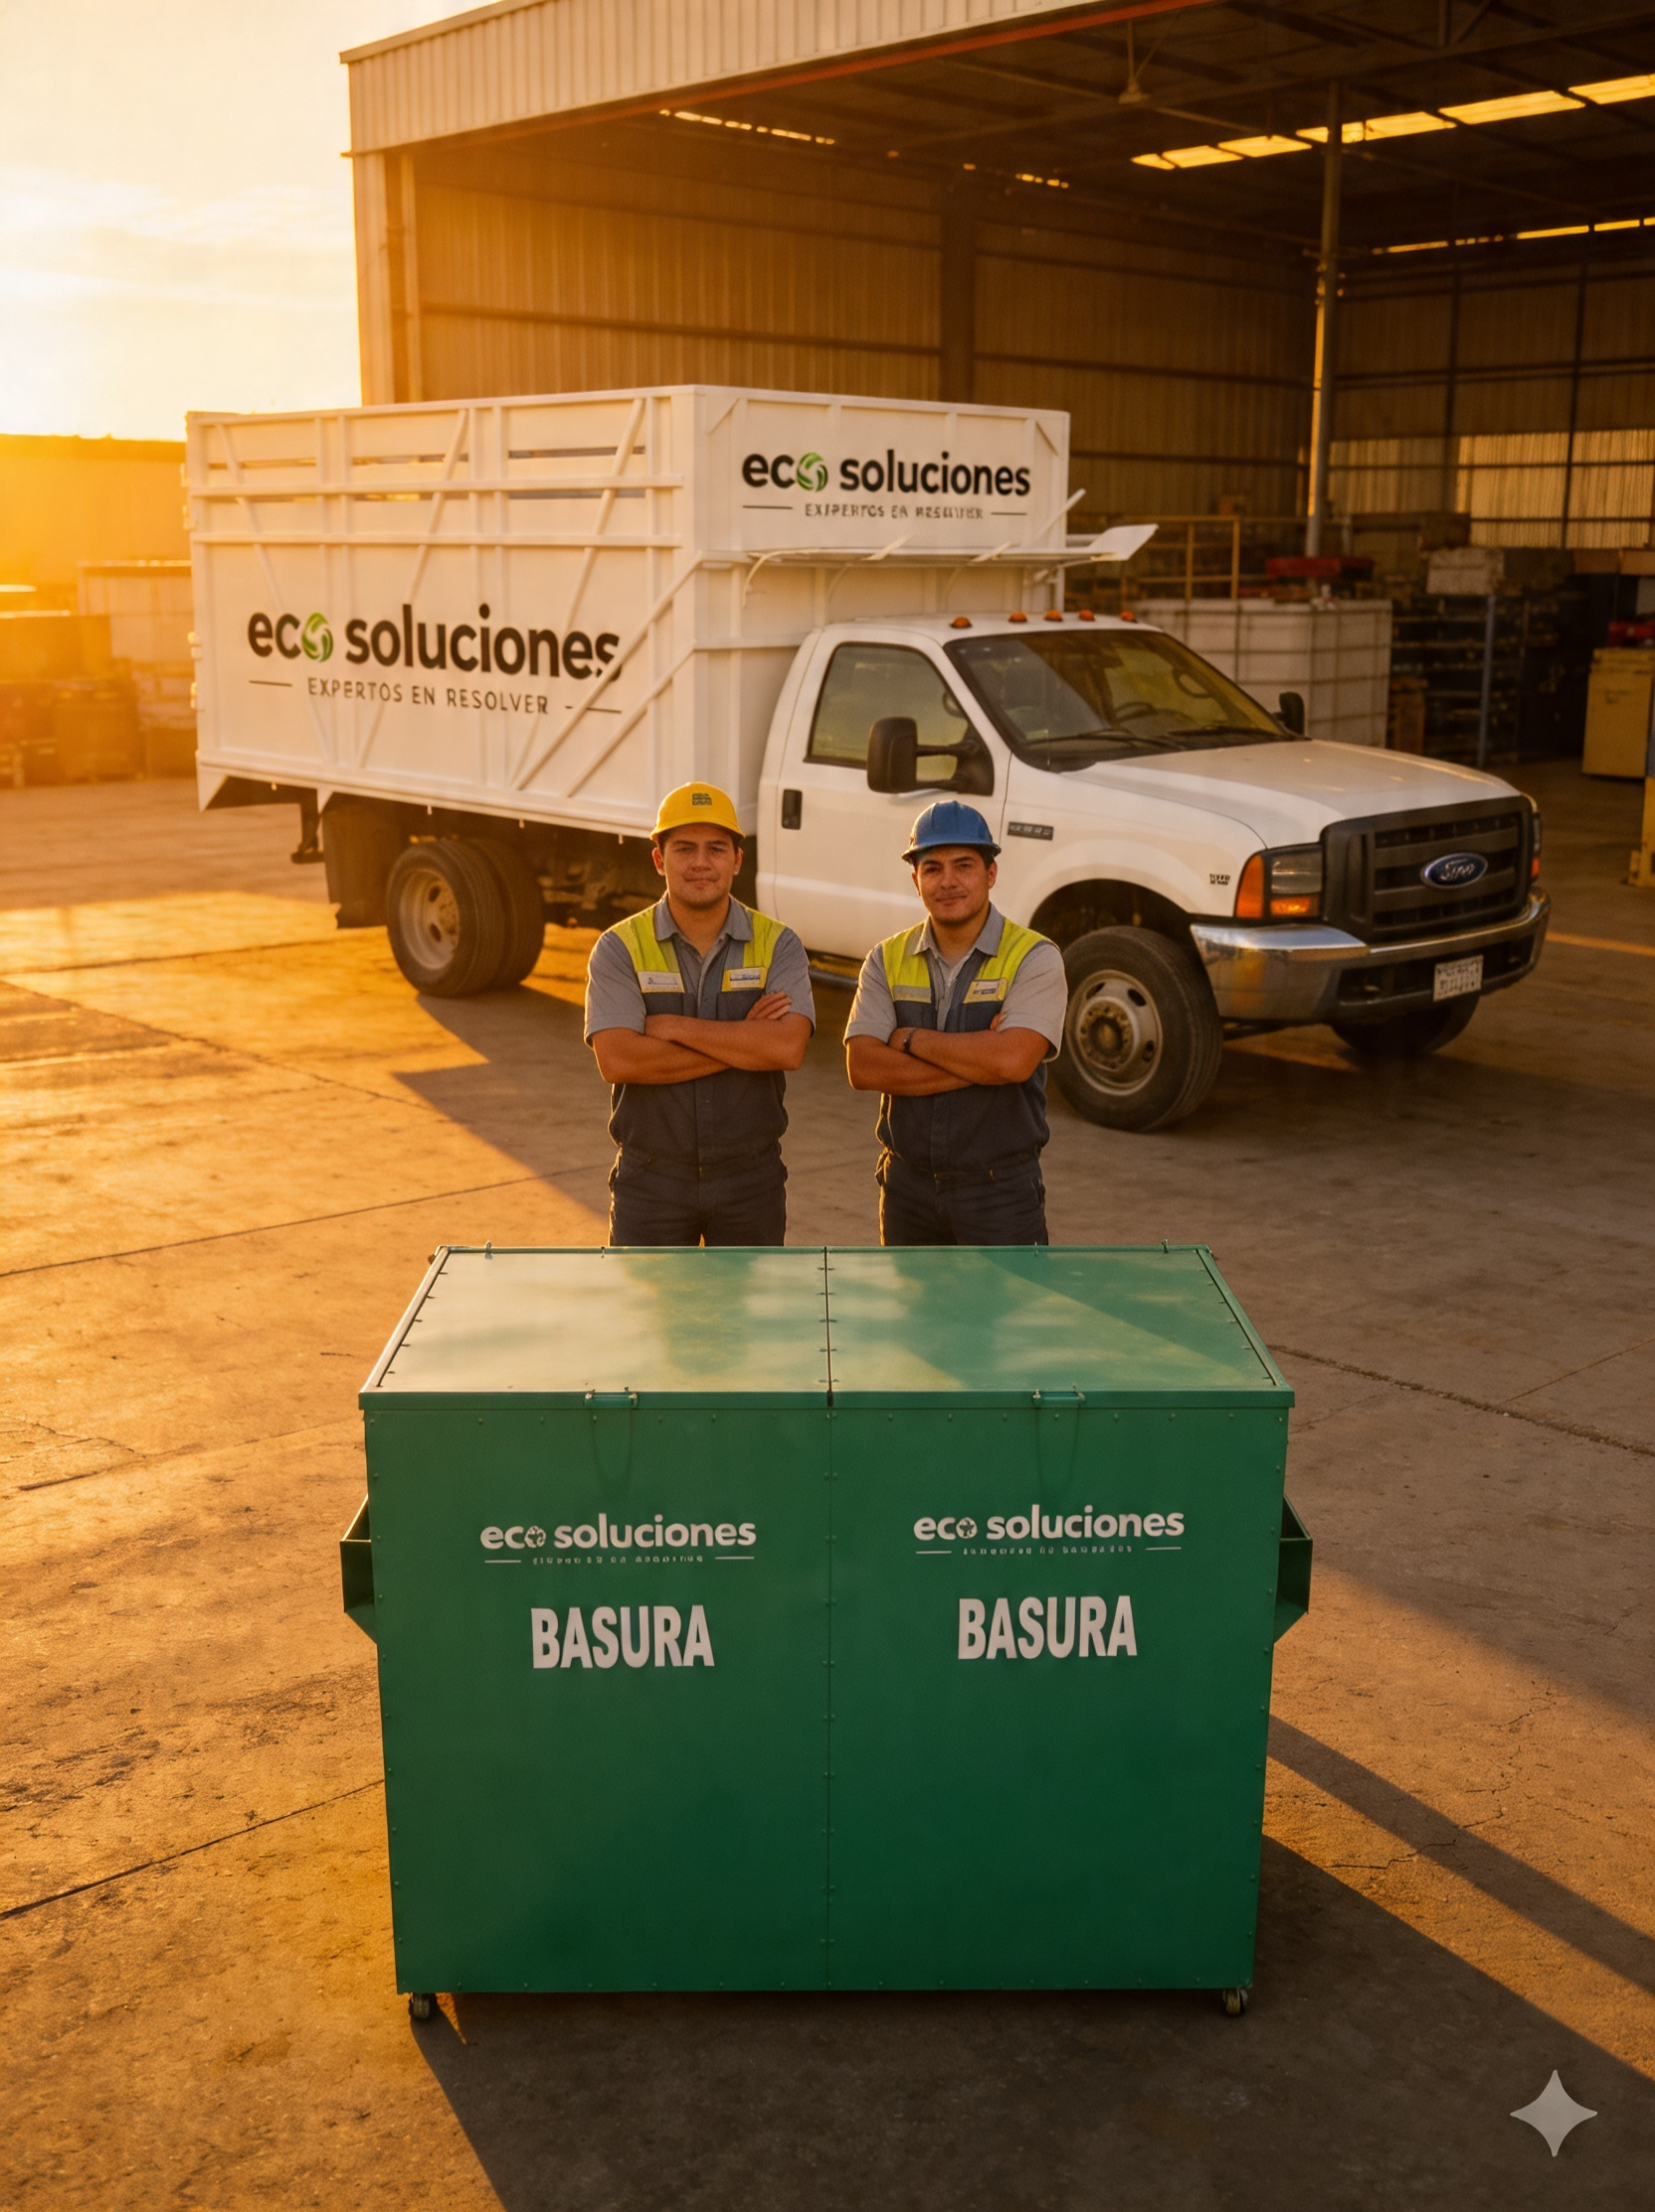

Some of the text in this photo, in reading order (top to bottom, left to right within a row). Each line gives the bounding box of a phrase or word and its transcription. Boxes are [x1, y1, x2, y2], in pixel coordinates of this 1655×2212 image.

[839, 449, 1031, 496] soluciones
[345, 602, 623, 682] soluciones
[308, 676, 549, 714] EXPERTOS EN RESOLVER
[554, 1513, 757, 1549] soluciones
[986, 1504, 1185, 1540] soluciones
[530, 1604, 715, 1669] BASURA
[958, 1594, 1138, 1660] BASURA
